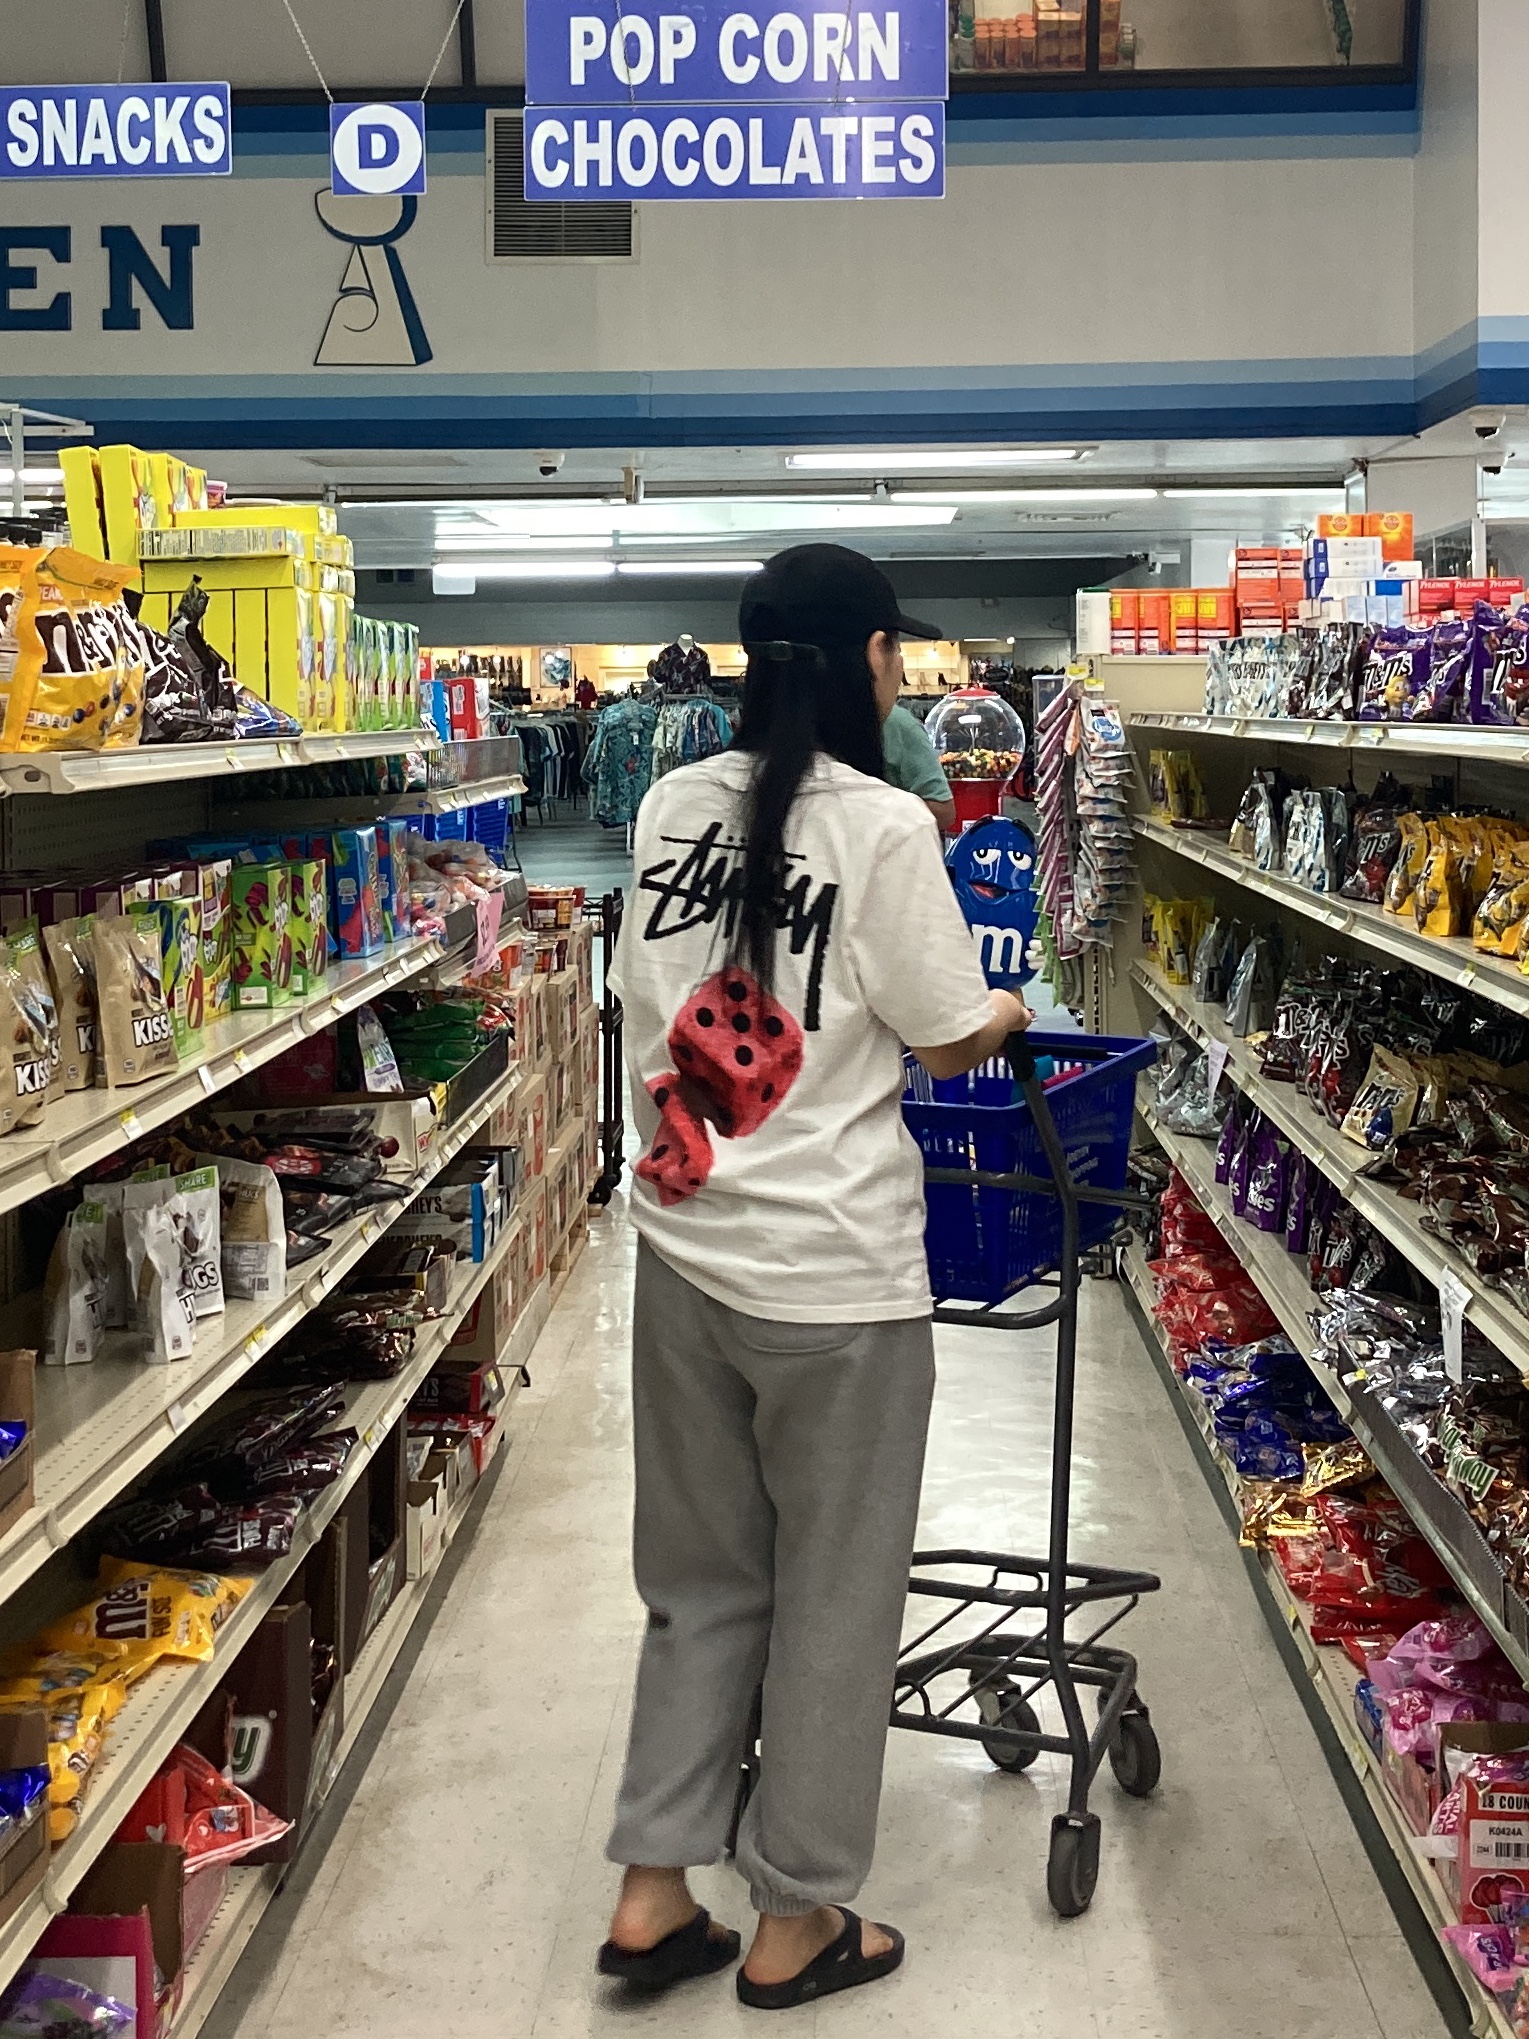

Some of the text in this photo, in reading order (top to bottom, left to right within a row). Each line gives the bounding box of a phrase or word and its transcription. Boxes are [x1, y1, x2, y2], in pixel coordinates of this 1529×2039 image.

[569, 11, 900, 86] POP CORN
[6, 94, 226, 168] SNACKS
[357, 123, 400, 170] D
[529, 113, 937, 190] CHOCOLATES
[971, 923, 1023, 974] m
[132, 1012, 173, 1048] KISS
[180, 1172, 207, 1192] SHARE
[1488, 1826, 1523, 1837] K0424A
